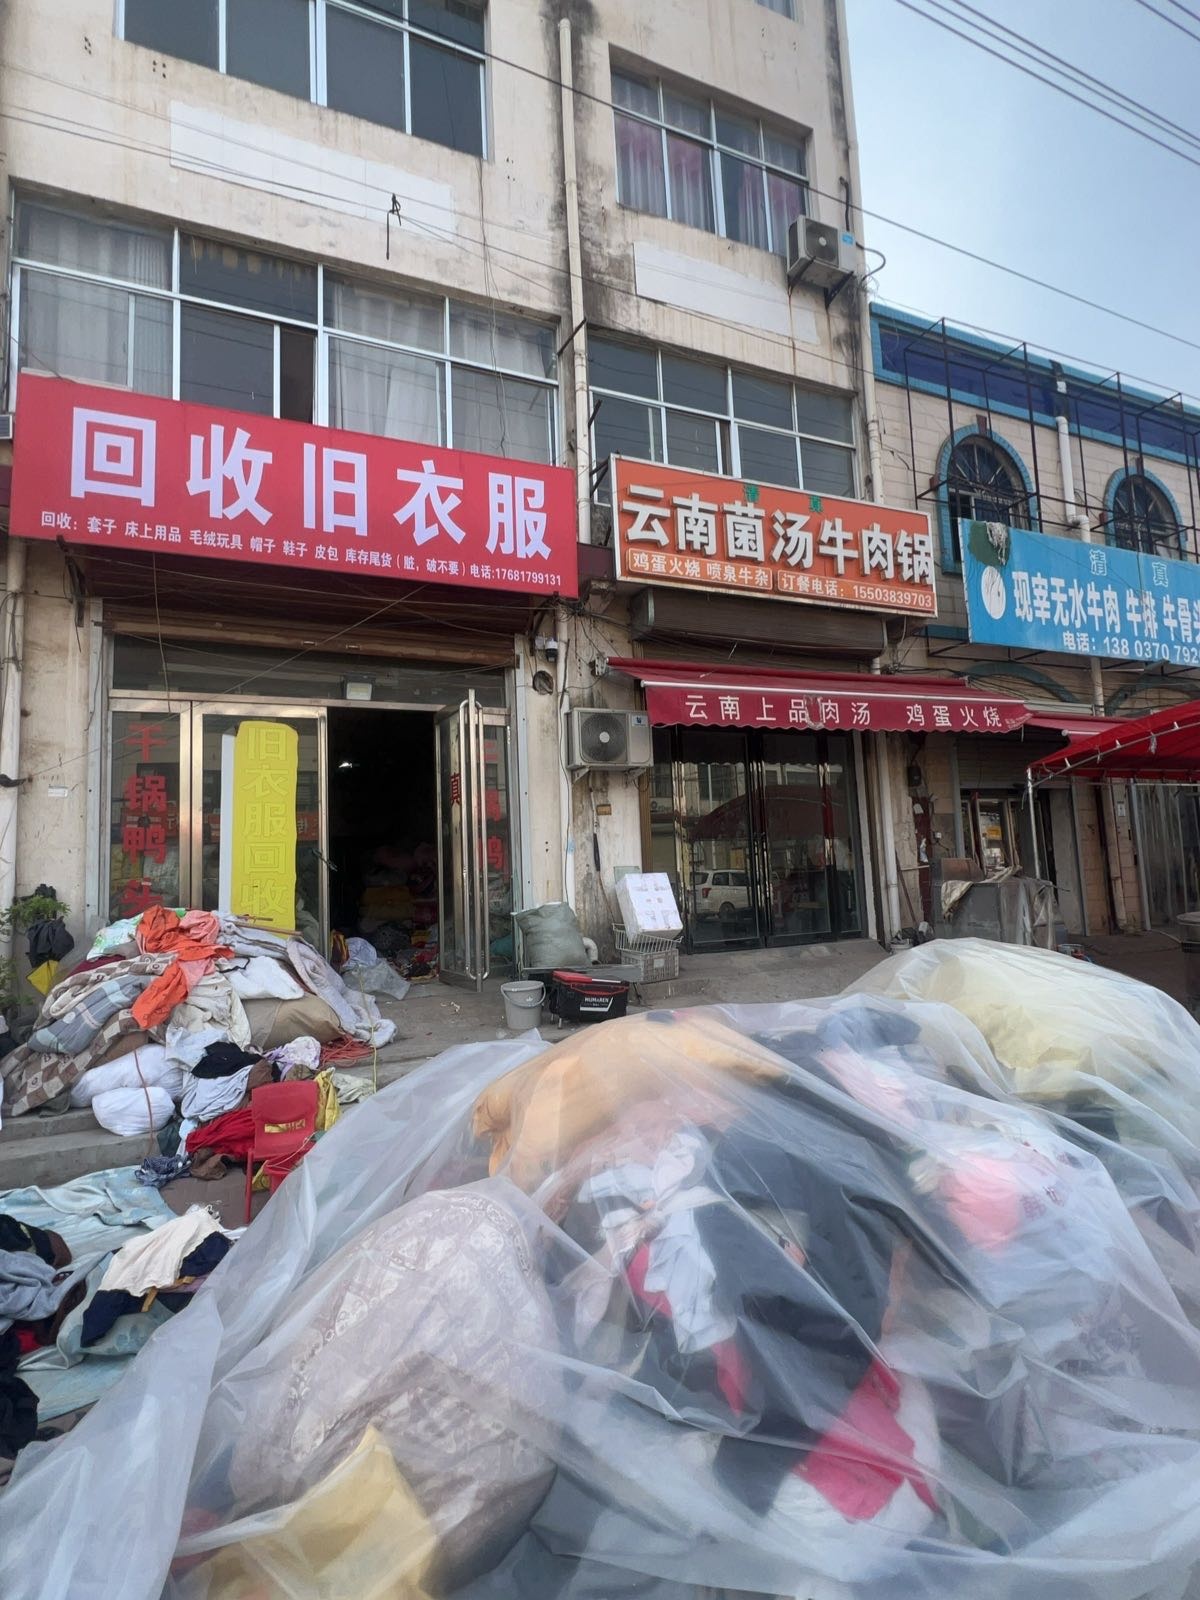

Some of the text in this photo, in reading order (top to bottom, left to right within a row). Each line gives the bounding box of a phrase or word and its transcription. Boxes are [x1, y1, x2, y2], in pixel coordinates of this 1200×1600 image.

[71, 406, 552, 561] 回收旧衣服
[87, 516, 117, 534] 套子
[124, 521, 182, 543] 床上用品
[189, 529, 243, 550] 毛绒玩具
[250, 535, 276, 554] 帽子
[282, 540, 308, 557] 鞋子
[314, 544, 339, 562] 皮包
[621, 484, 934, 585] 云南菌汤牛肉锅
[632, 552, 769, 587] 鸡蛋火烧 喷泉牛杂
[852, 584, 932, 608] 15503839703
[1011, 570, 1121, 634] 现宰无水牛肉
[1126, 588, 1158, 640] 牛排
[1103, 636, 1130, 656] 138
[1134, 641, 1170, 662] 0370
[1174, 645, 1200, 664] 792
[685, 694, 871, 726] 云南上品肉汤
[906, 703, 1003, 728] 鸡蛋火烧
[120, 723, 168, 917] 干锅鸭头
[240, 727, 289, 915] 旧衣服回收
